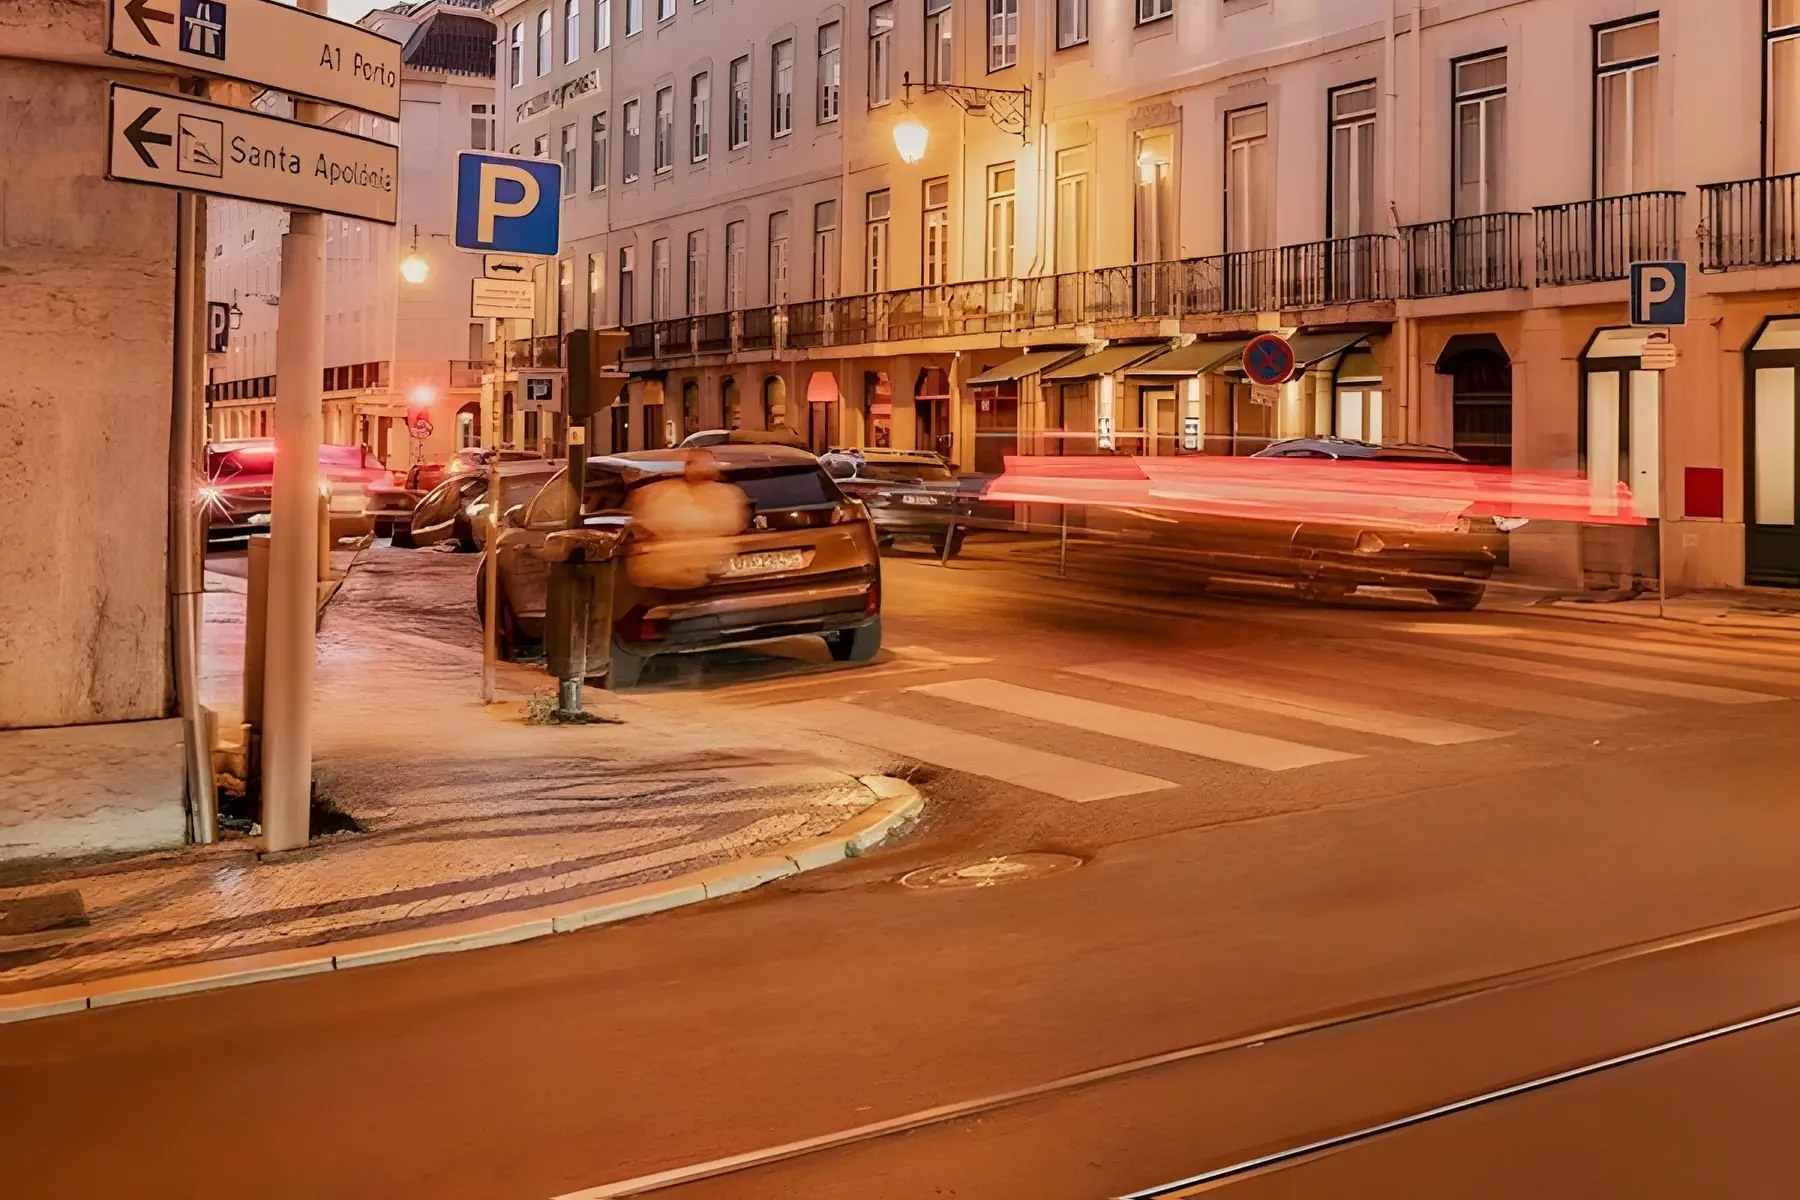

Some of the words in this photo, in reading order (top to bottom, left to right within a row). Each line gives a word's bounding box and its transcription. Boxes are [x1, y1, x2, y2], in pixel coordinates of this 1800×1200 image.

[320, 43, 341, 71] A1
[230, 135, 300, 174] Santa
[477, 162, 541, 243] P
[1641, 267, 1675, 321] P
[210, 305, 225, 350] P
